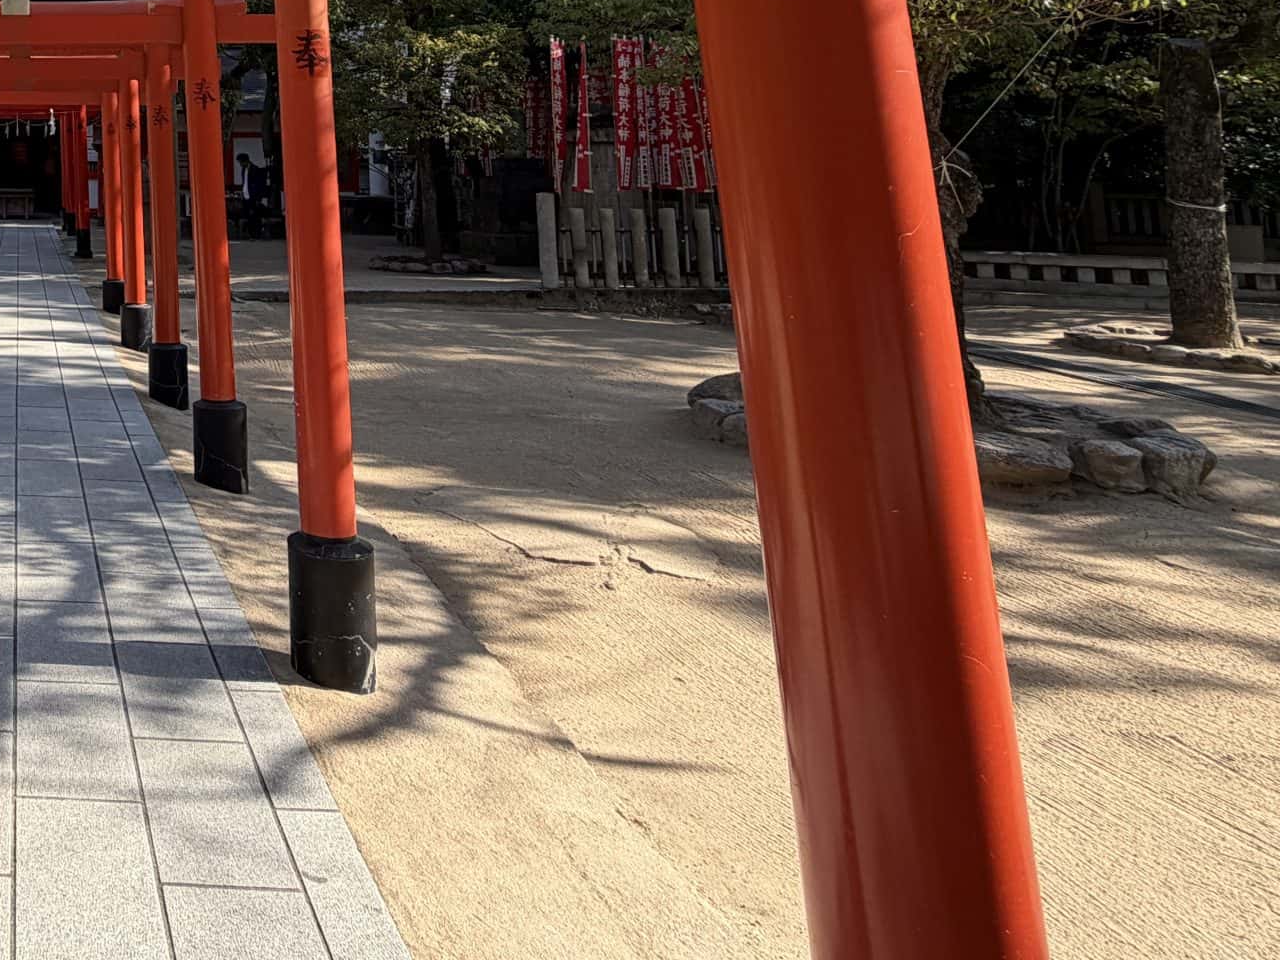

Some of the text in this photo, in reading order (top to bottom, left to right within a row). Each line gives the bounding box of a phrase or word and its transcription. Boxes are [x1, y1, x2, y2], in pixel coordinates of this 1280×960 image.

[292, 29, 327, 77] 奉
[192, 78, 216, 111] 奉
[152, 104, 168, 129] 奉
